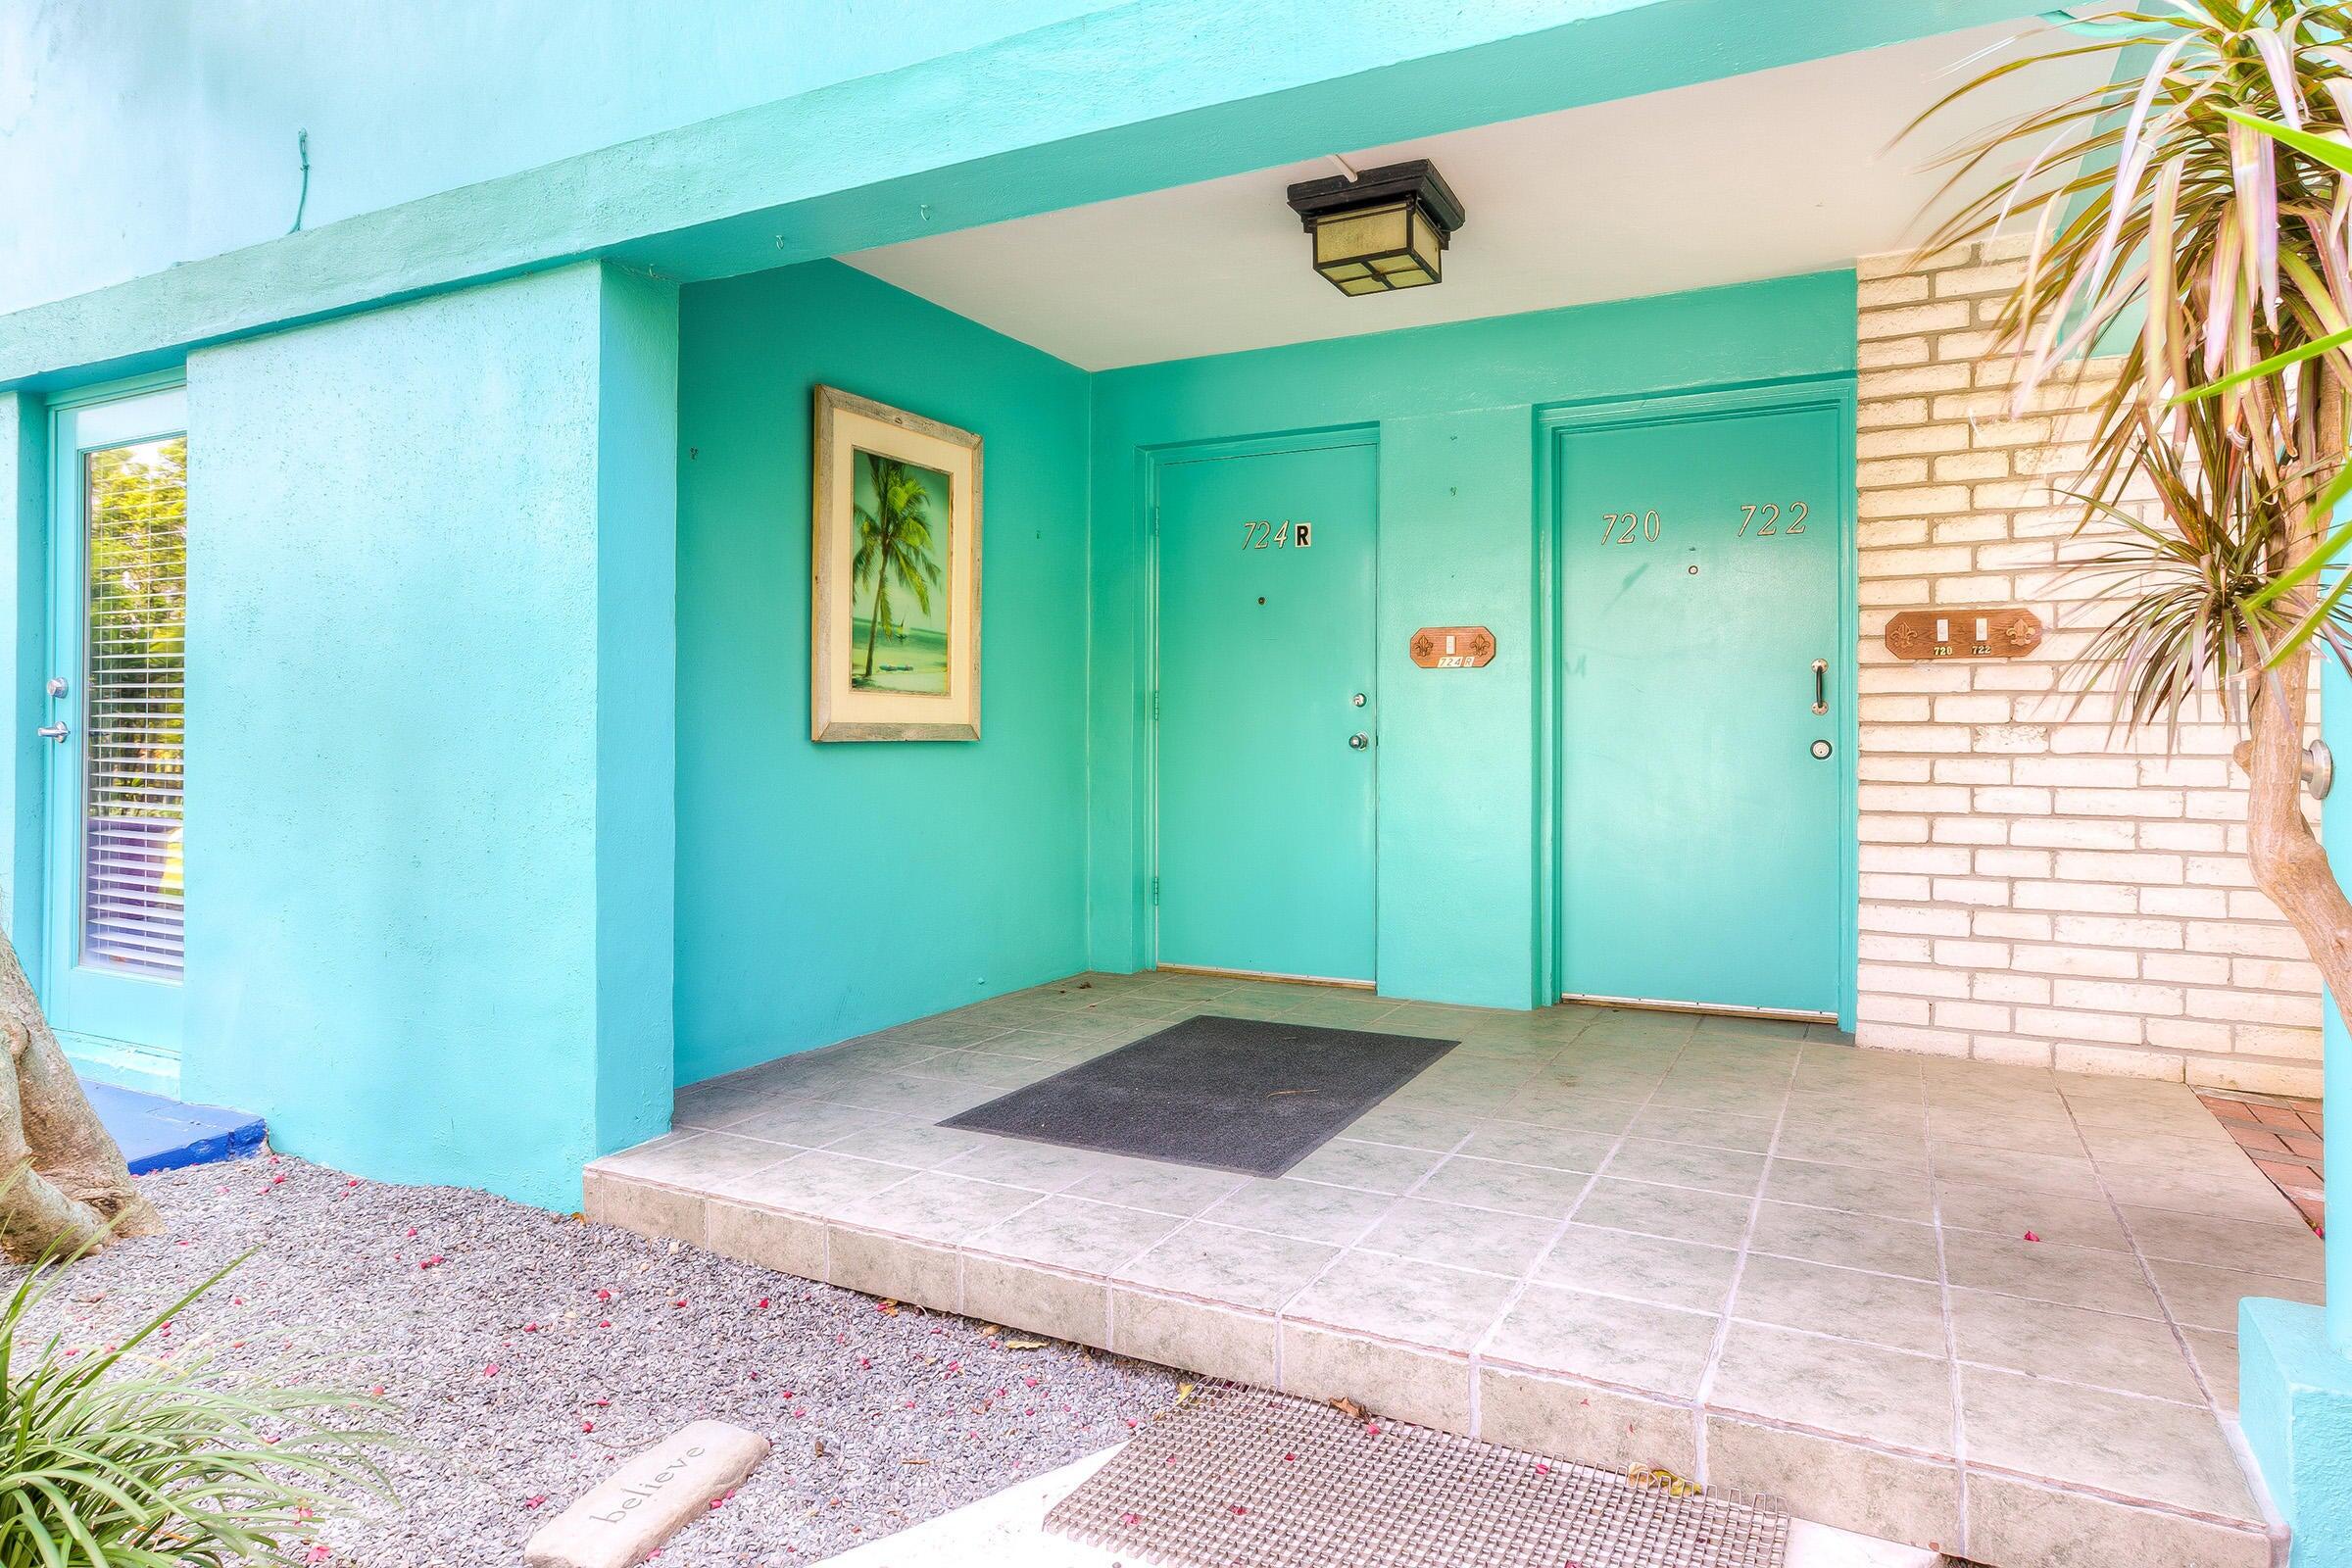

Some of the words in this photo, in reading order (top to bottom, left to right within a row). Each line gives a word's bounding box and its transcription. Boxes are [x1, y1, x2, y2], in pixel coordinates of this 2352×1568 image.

[1601, 510, 1660, 545] 720
[1737, 501, 1809, 537] 722
[1934, 647, 1953, 656] 720
[1972, 645, 1991, 655] 722
[589, 1446, 706, 1524] believe
